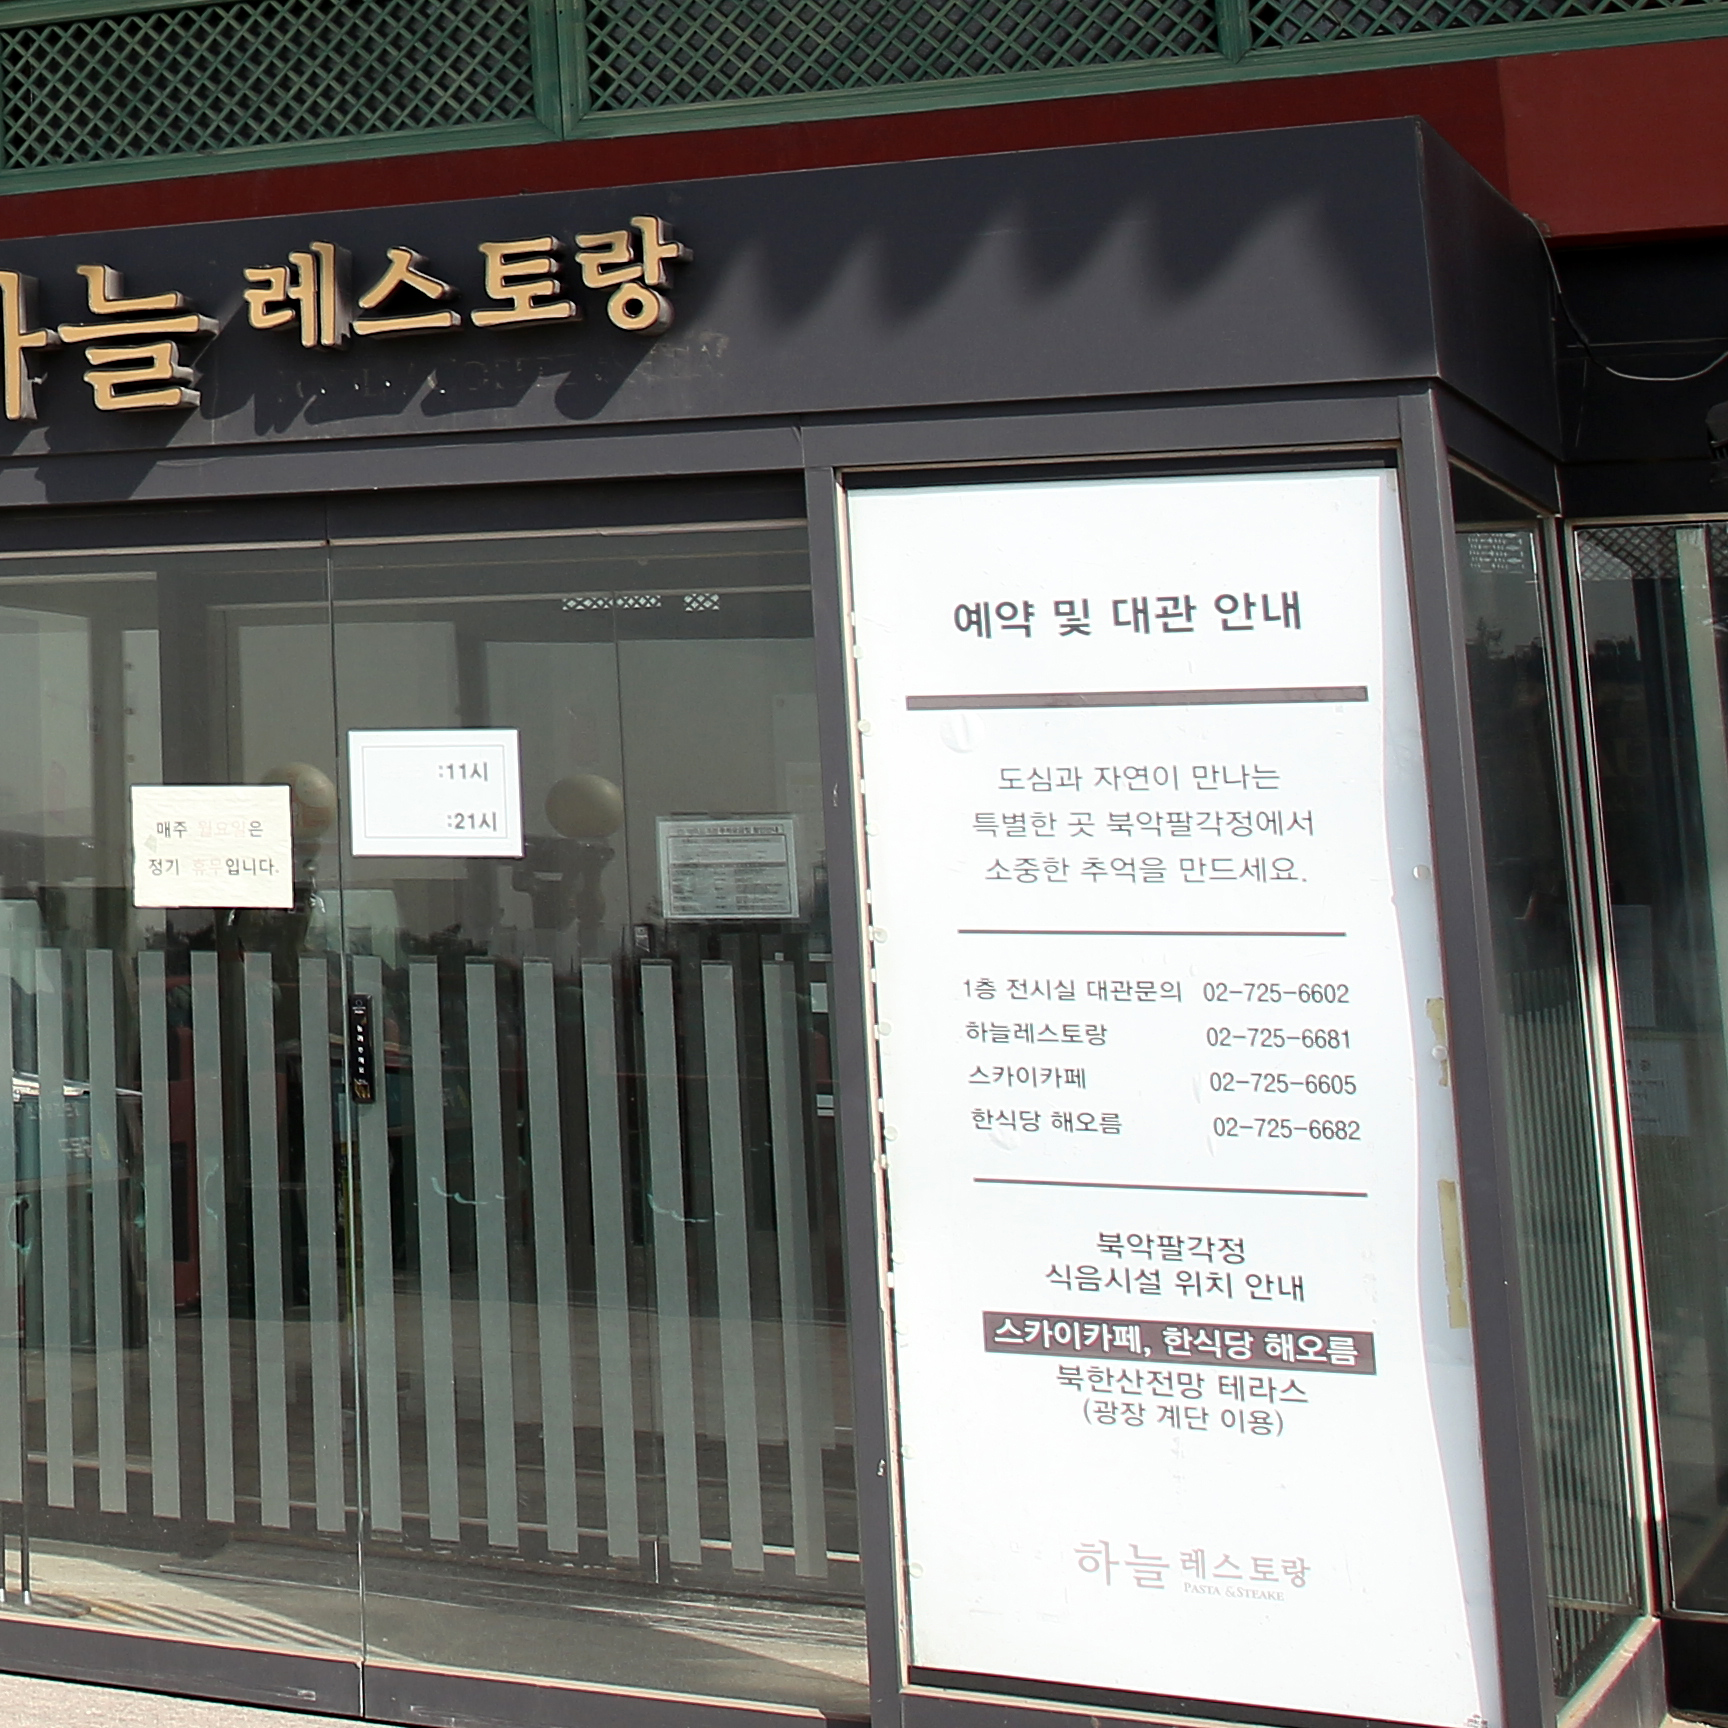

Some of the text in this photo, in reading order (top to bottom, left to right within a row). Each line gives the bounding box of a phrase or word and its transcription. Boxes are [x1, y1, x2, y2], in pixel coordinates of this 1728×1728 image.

[243, 215, 692, 351] 레스토랑
[953, 590, 1302, 639] 예약 및 대관 안내
[998, 763, 1281, 792] 도심과 자연이 만나는
[156, 821, 188, 839] 매주
[972, 809, 1315, 838] 특별한 곳 북악팔각정에서
[148, 858, 179, 877] 정기
[985, 856, 1308, 884] 소중한 추억을 만드세요.
[963, 977, 1351, 1005] 1층 전시실 대관문의 02-725-6602
[965, 1022, 1351, 1050] 하늘레스토랑 02-725-6681
[968, 1066, 1357, 1095] 스카이카페 02-725-6605
[971, 1108, 1362, 1142] 한식당 해오름 02-725-6682
[1096, 1231, 1246, 1265] 북악팔각정
[1045, 1263, 1306, 1303] 식음시설 위치 안내
[994, 1318, 1359, 1366] 스카이카페, 한식당 해오름
[1056, 1364, 1310, 1404] 북한산전망 테라스
[1083, 1397, 1284, 1438] (광장 계단 이용)
[1073, 1539, 1311, 1590] 하늘 레스토랑
[1183, 1581, 1221, 1597] PASTA
